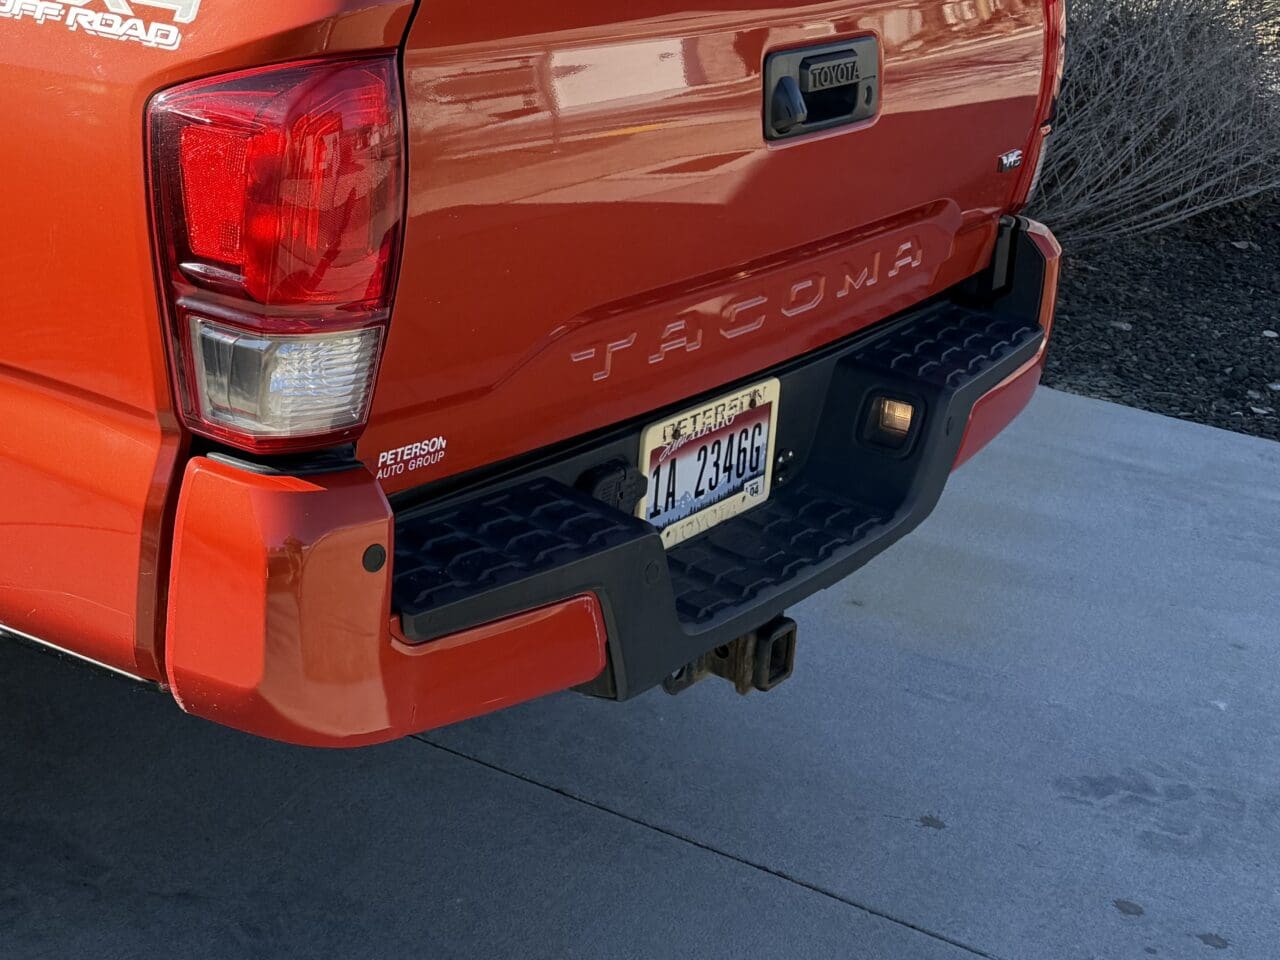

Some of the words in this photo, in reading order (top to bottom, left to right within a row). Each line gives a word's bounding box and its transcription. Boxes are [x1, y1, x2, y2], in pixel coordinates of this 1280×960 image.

[65, 7, 183, 52] ROAD
[811, 61, 860, 88] TOYOTA
[571, 241, 923, 382] TACOMA
[376, 463, 404, 480] AUTO
[408, 451, 445, 470] GROUP
[378, 436, 447, 467] PETERSON
[650, 458, 677, 519] 1A
[694, 422, 762, 499] 2346G
